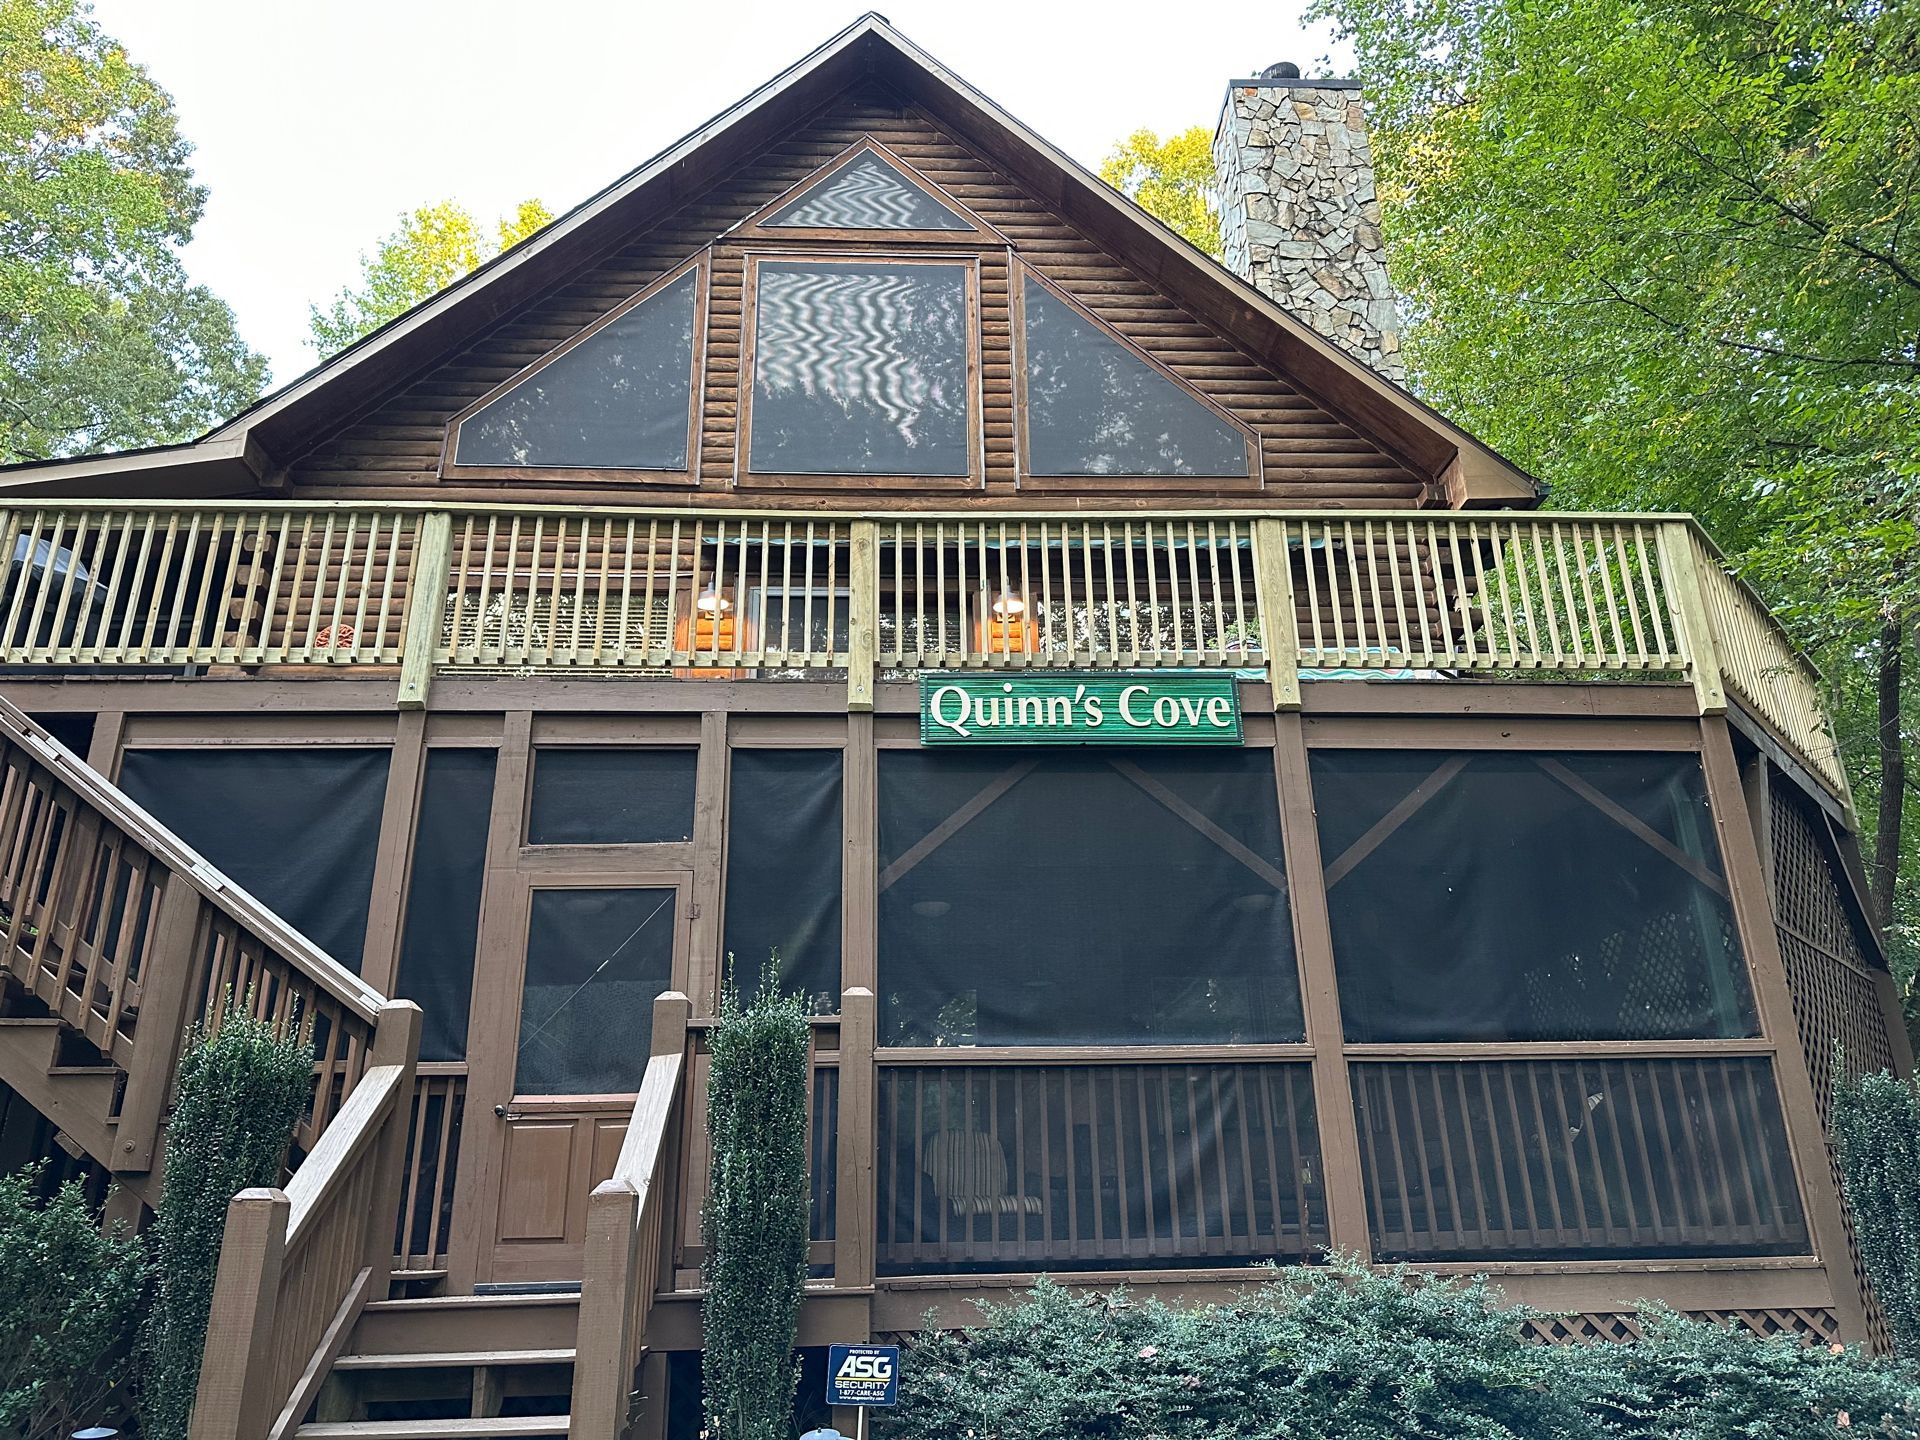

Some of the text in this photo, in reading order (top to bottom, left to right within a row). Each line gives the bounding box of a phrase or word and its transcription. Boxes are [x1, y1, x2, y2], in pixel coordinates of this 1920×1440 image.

[931, 682, 1232, 738] Quinn's Cove
[836, 1355, 892, 1378] ASG
[834, 1381, 890, 1390] SECURITY
